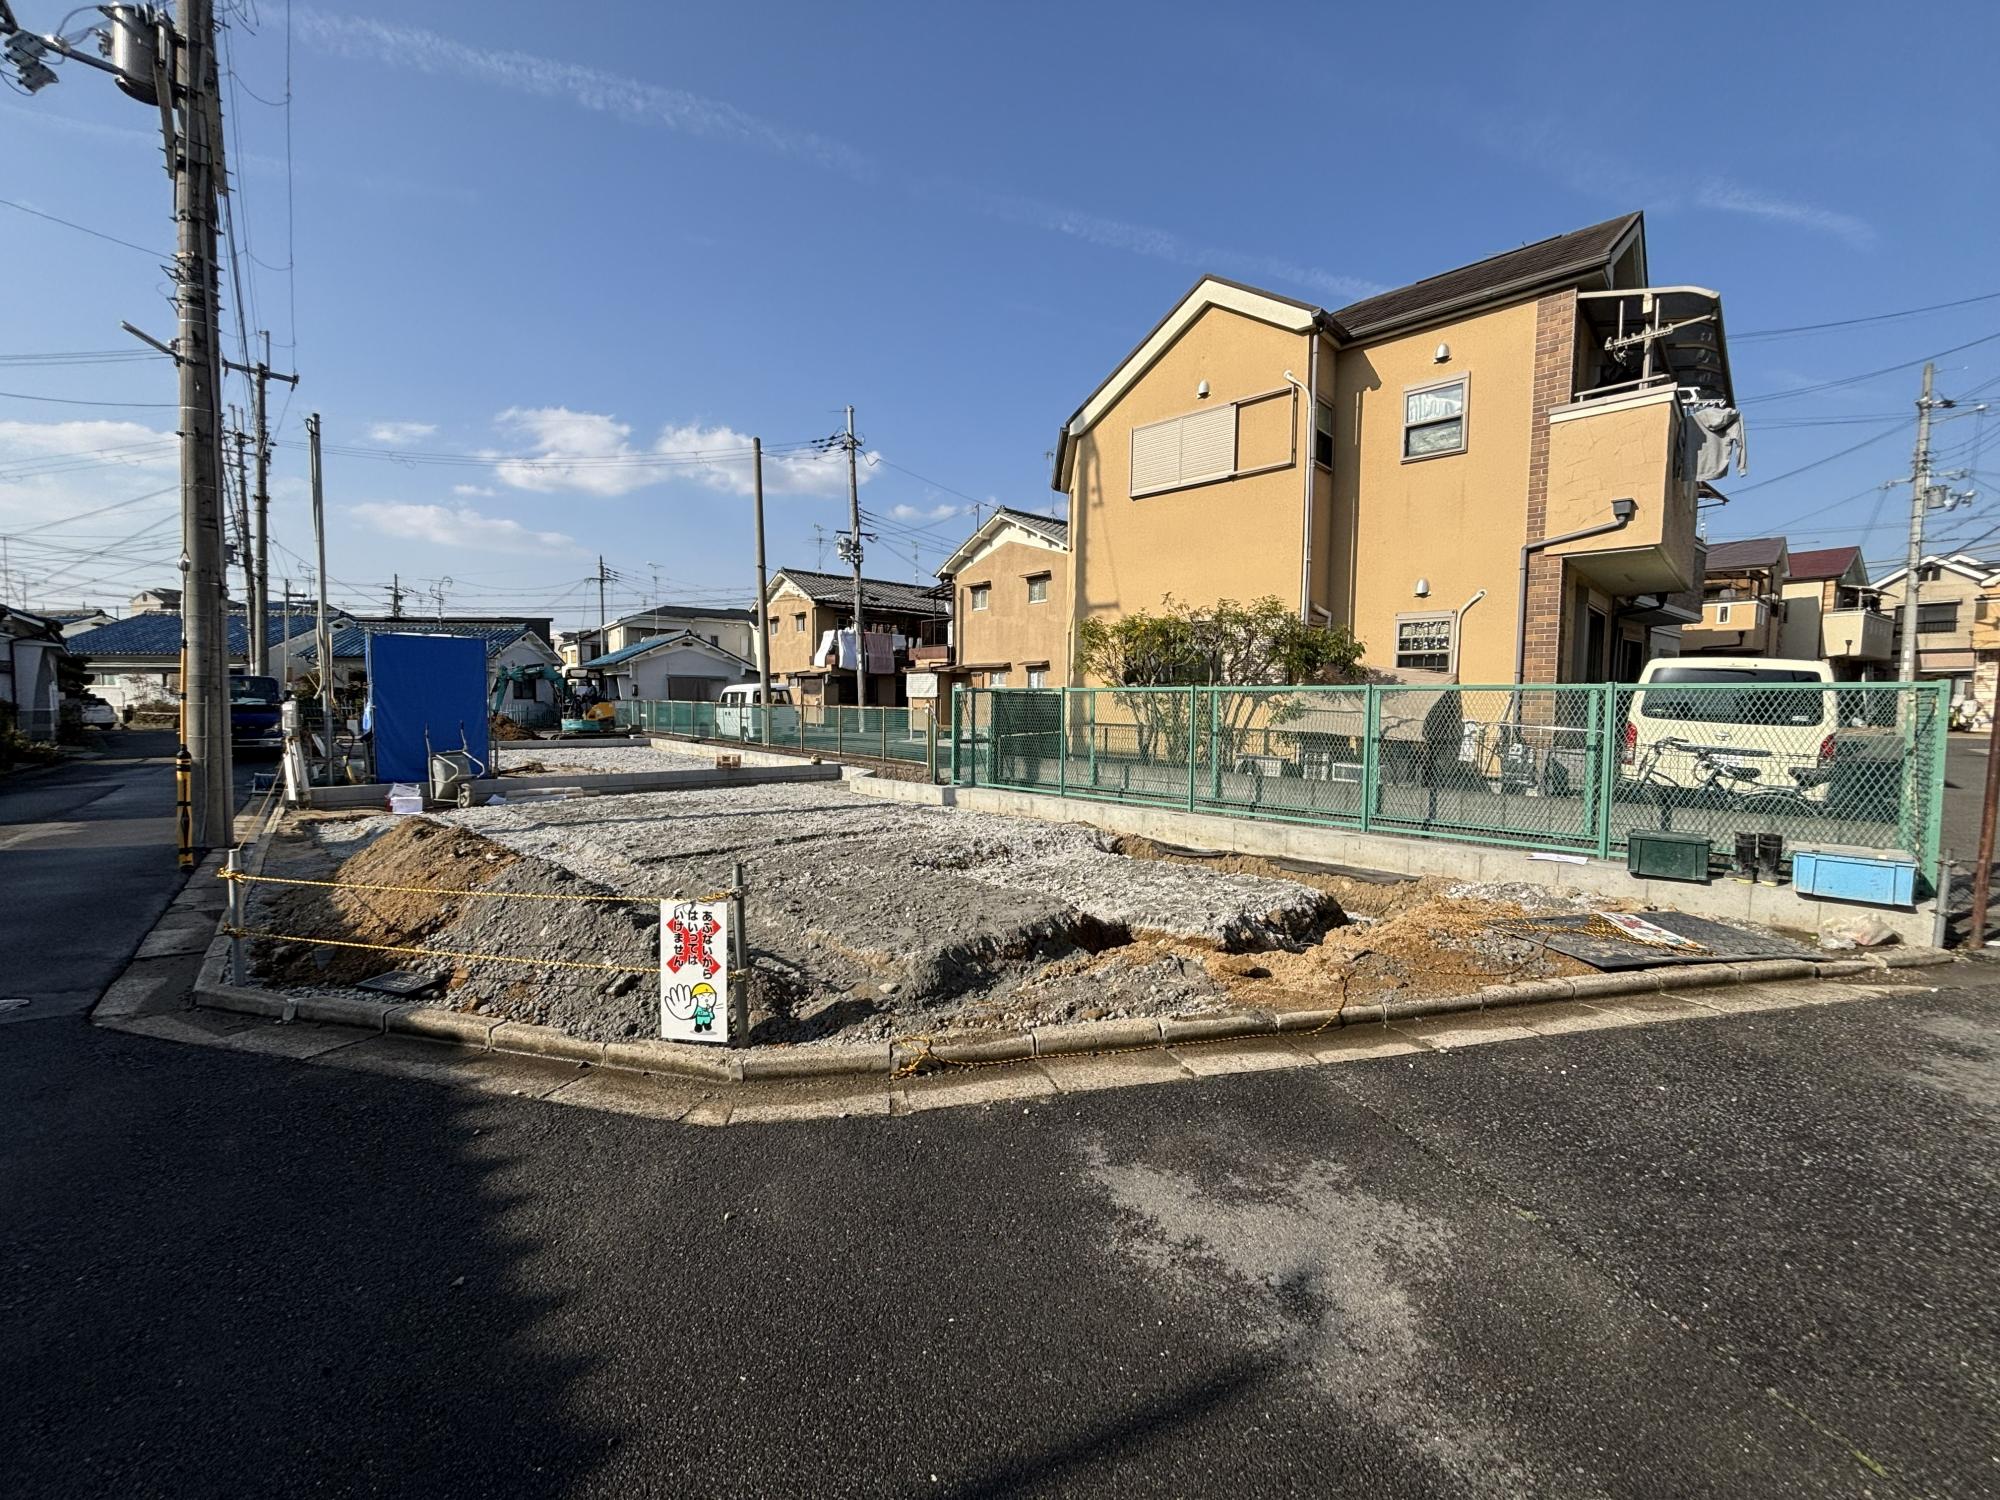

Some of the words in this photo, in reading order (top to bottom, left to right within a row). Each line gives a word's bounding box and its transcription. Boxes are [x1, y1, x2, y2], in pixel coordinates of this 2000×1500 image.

[674, 910, 684, 967] いけません
[688, 910, 698, 965] はいっては
